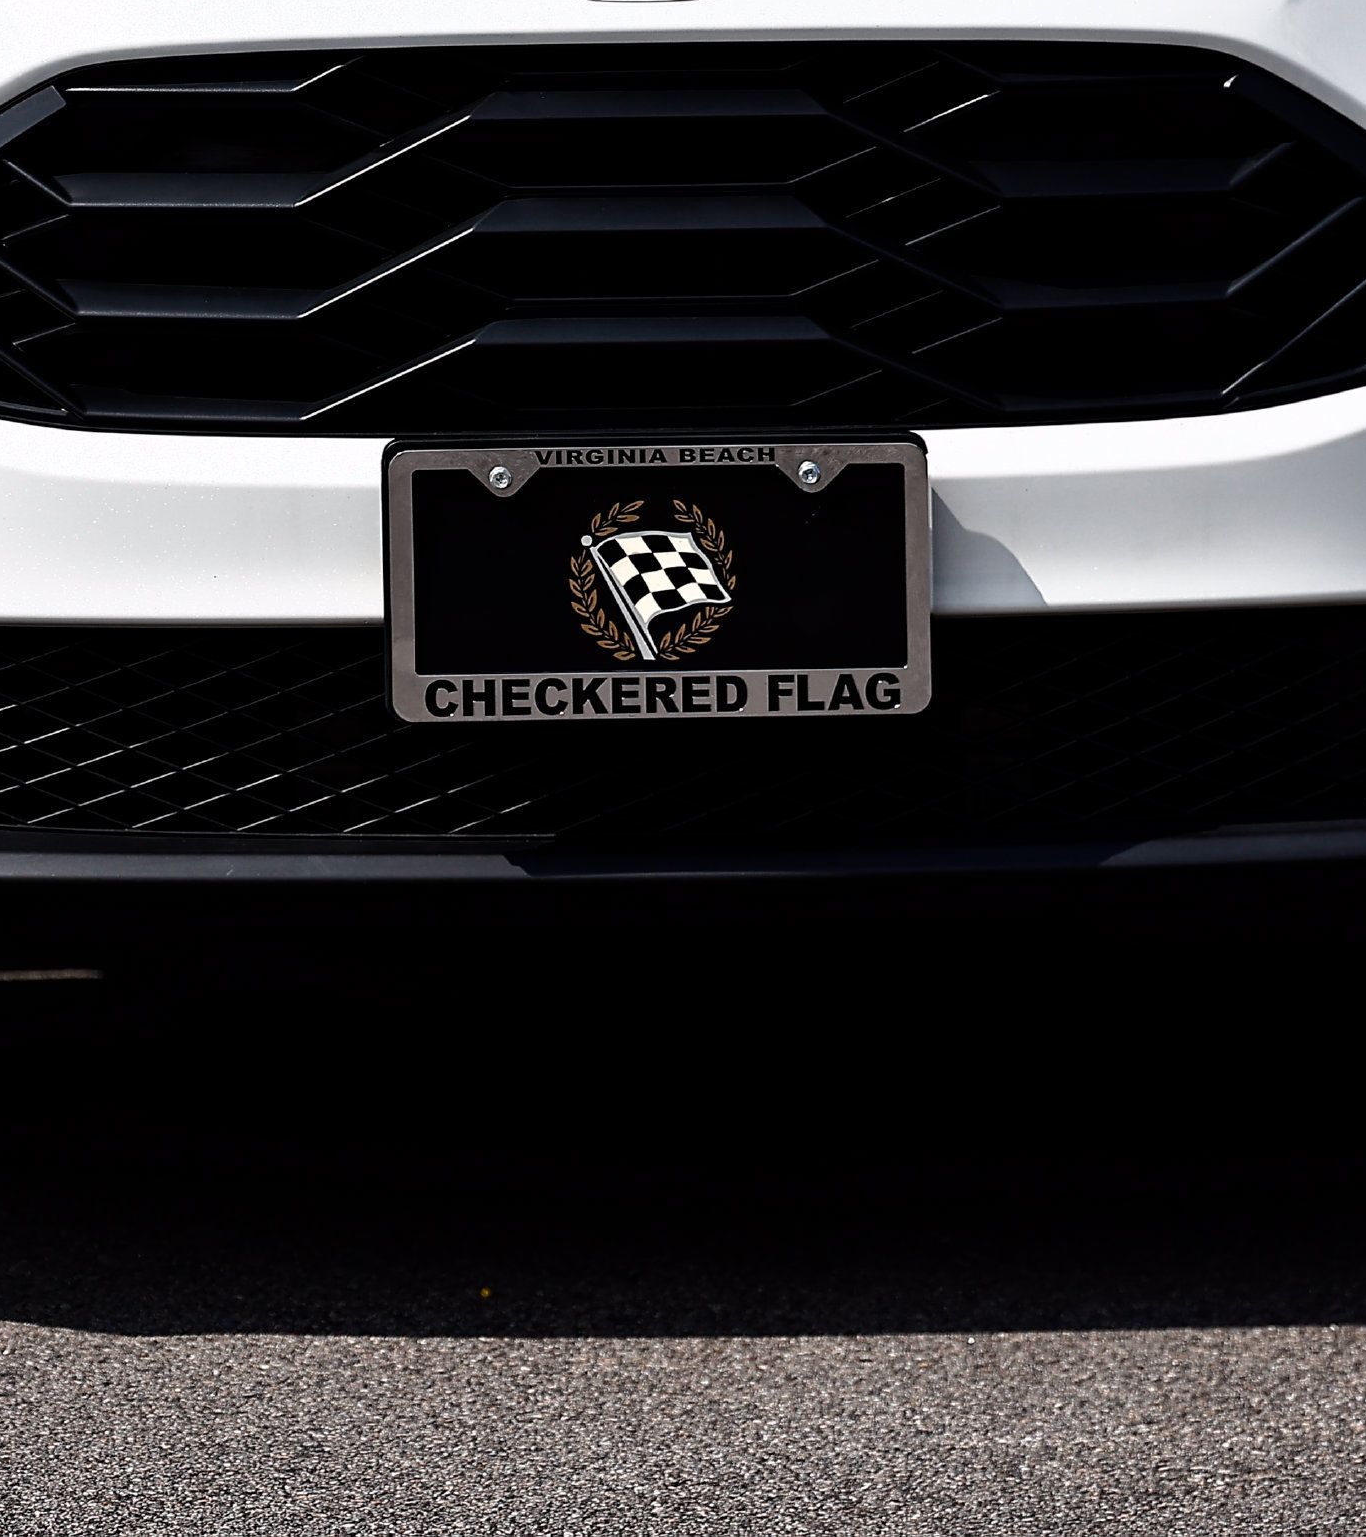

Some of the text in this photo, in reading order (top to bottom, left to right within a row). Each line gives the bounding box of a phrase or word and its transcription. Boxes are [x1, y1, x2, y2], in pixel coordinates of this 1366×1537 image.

[535, 447, 776, 465] VIRGINIA BEACH
[424, 672, 902, 717] CHECKERED FLAG
